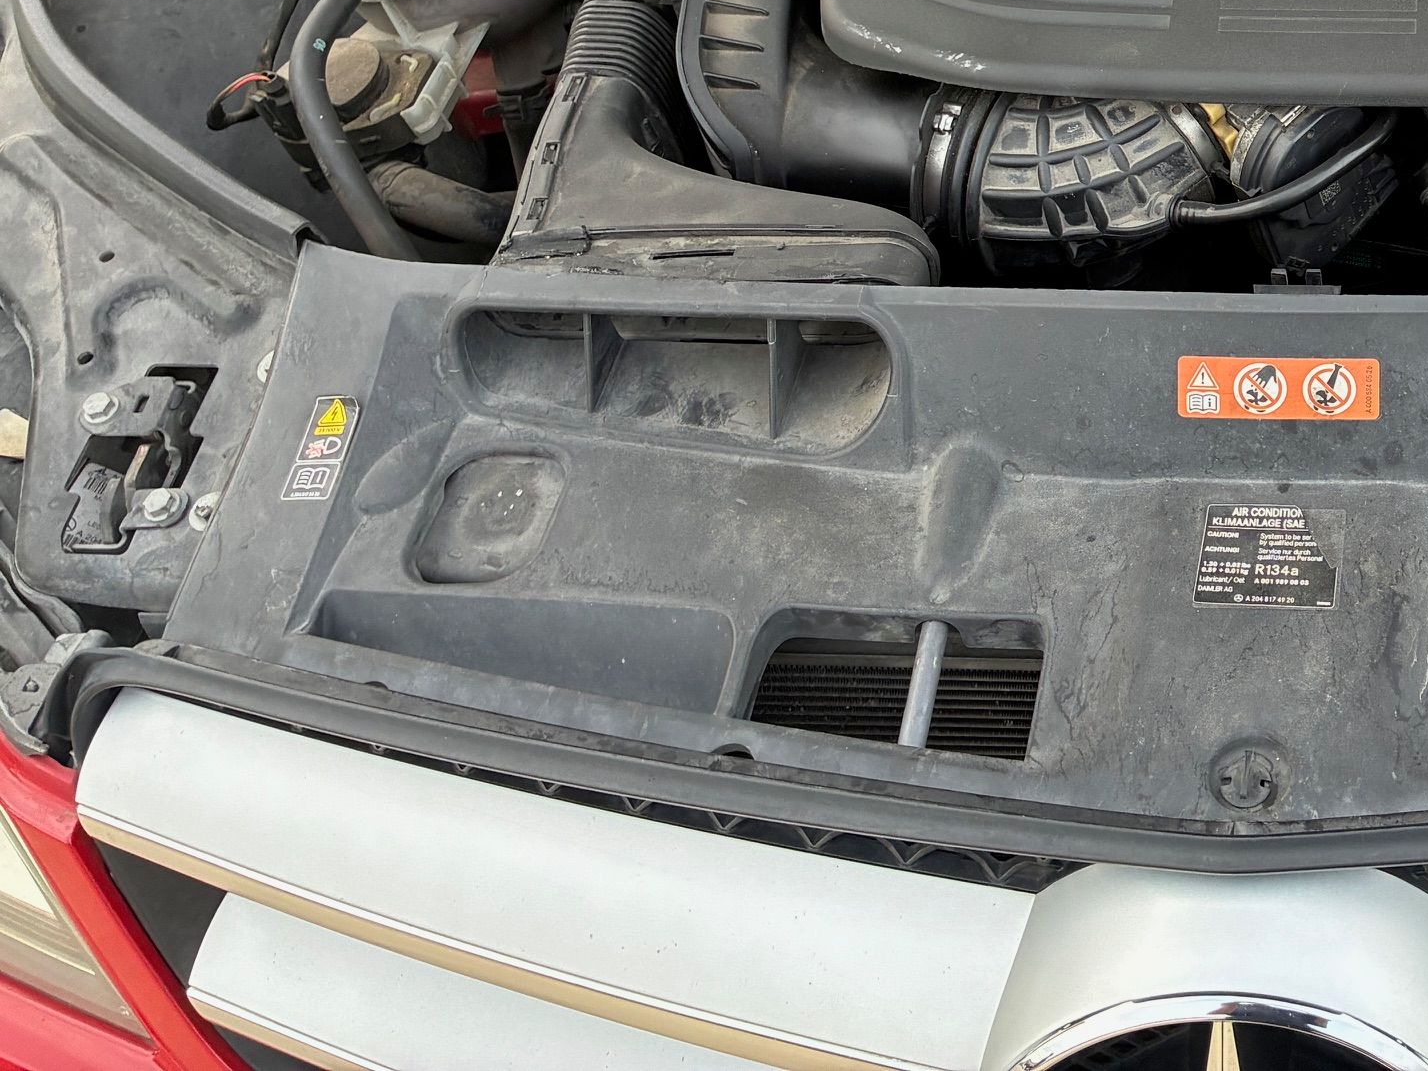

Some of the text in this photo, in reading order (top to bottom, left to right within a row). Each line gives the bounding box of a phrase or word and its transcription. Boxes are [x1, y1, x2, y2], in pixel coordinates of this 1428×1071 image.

[1232, 507, 1249, 517] AIR
[1212, 517, 1305, 530] KLIMAANLAGE (SAE
[1260, 532, 1284, 540] System
[1254, 563, 1299, 576] R134a
[1198, 584, 1223, 592] DAIMLER
